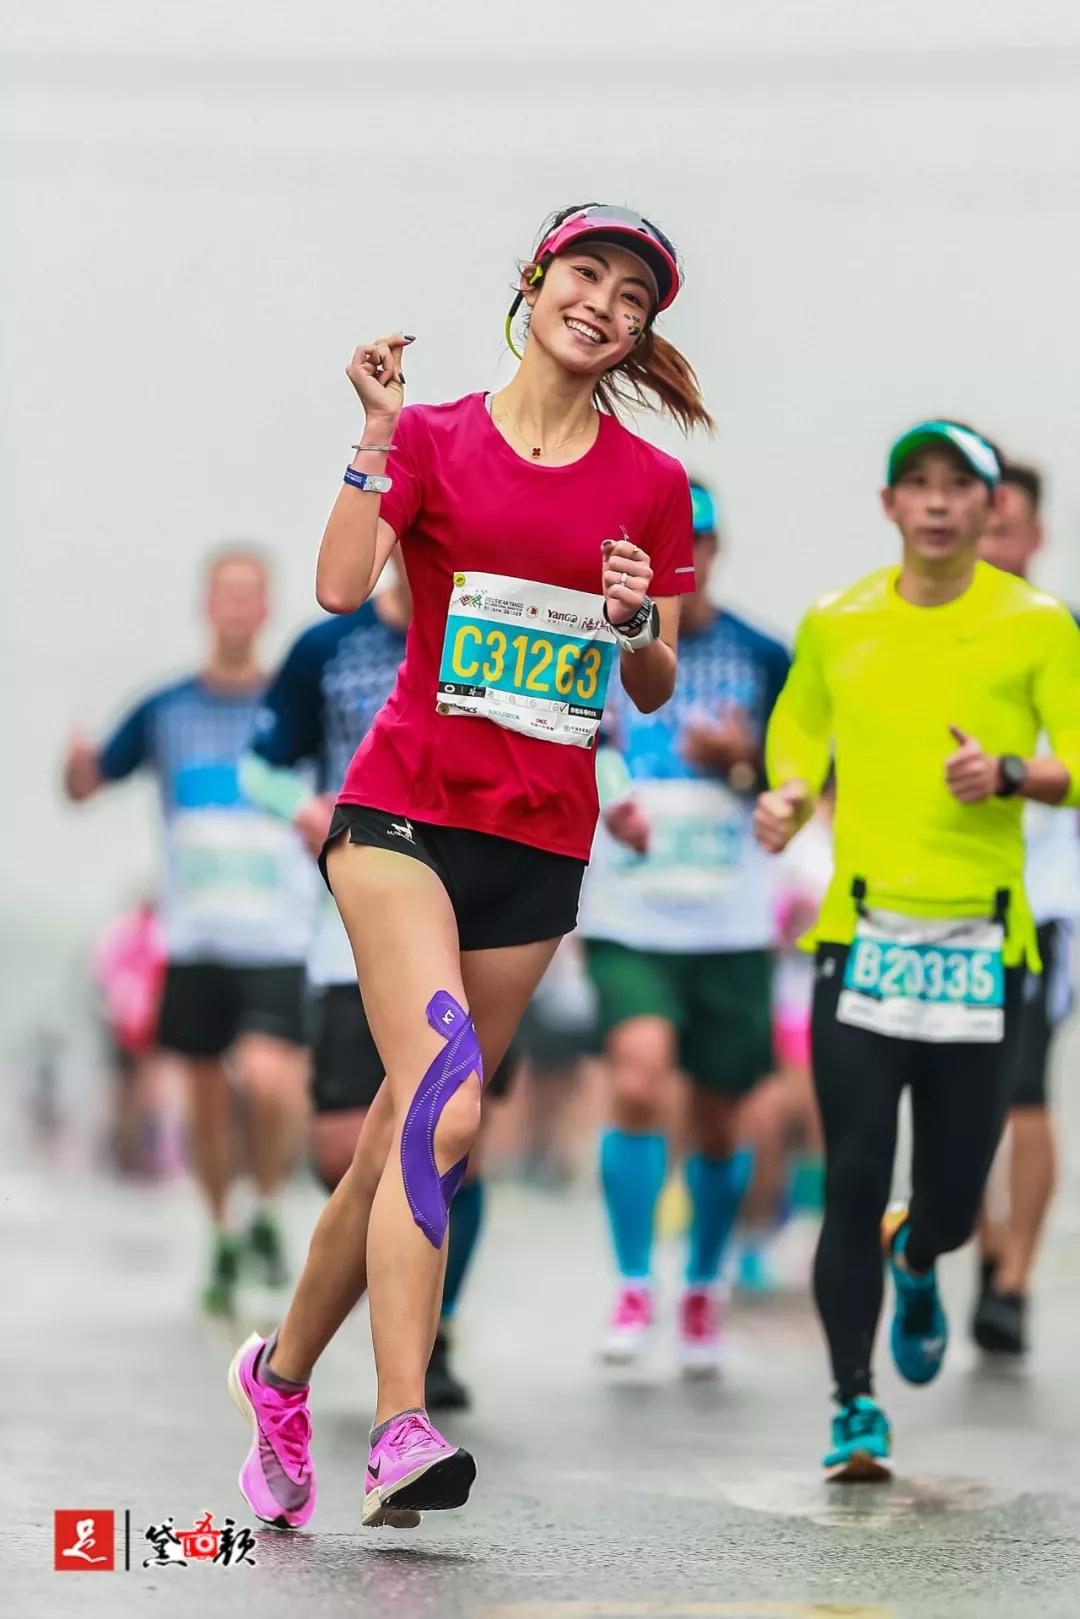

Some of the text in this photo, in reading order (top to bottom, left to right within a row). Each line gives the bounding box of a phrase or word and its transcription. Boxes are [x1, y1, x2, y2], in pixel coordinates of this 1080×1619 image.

[452, 625, 602, 700] C31263
[852, 940, 995, 1001] B20335
[442, 1009, 455, 1025] KT
